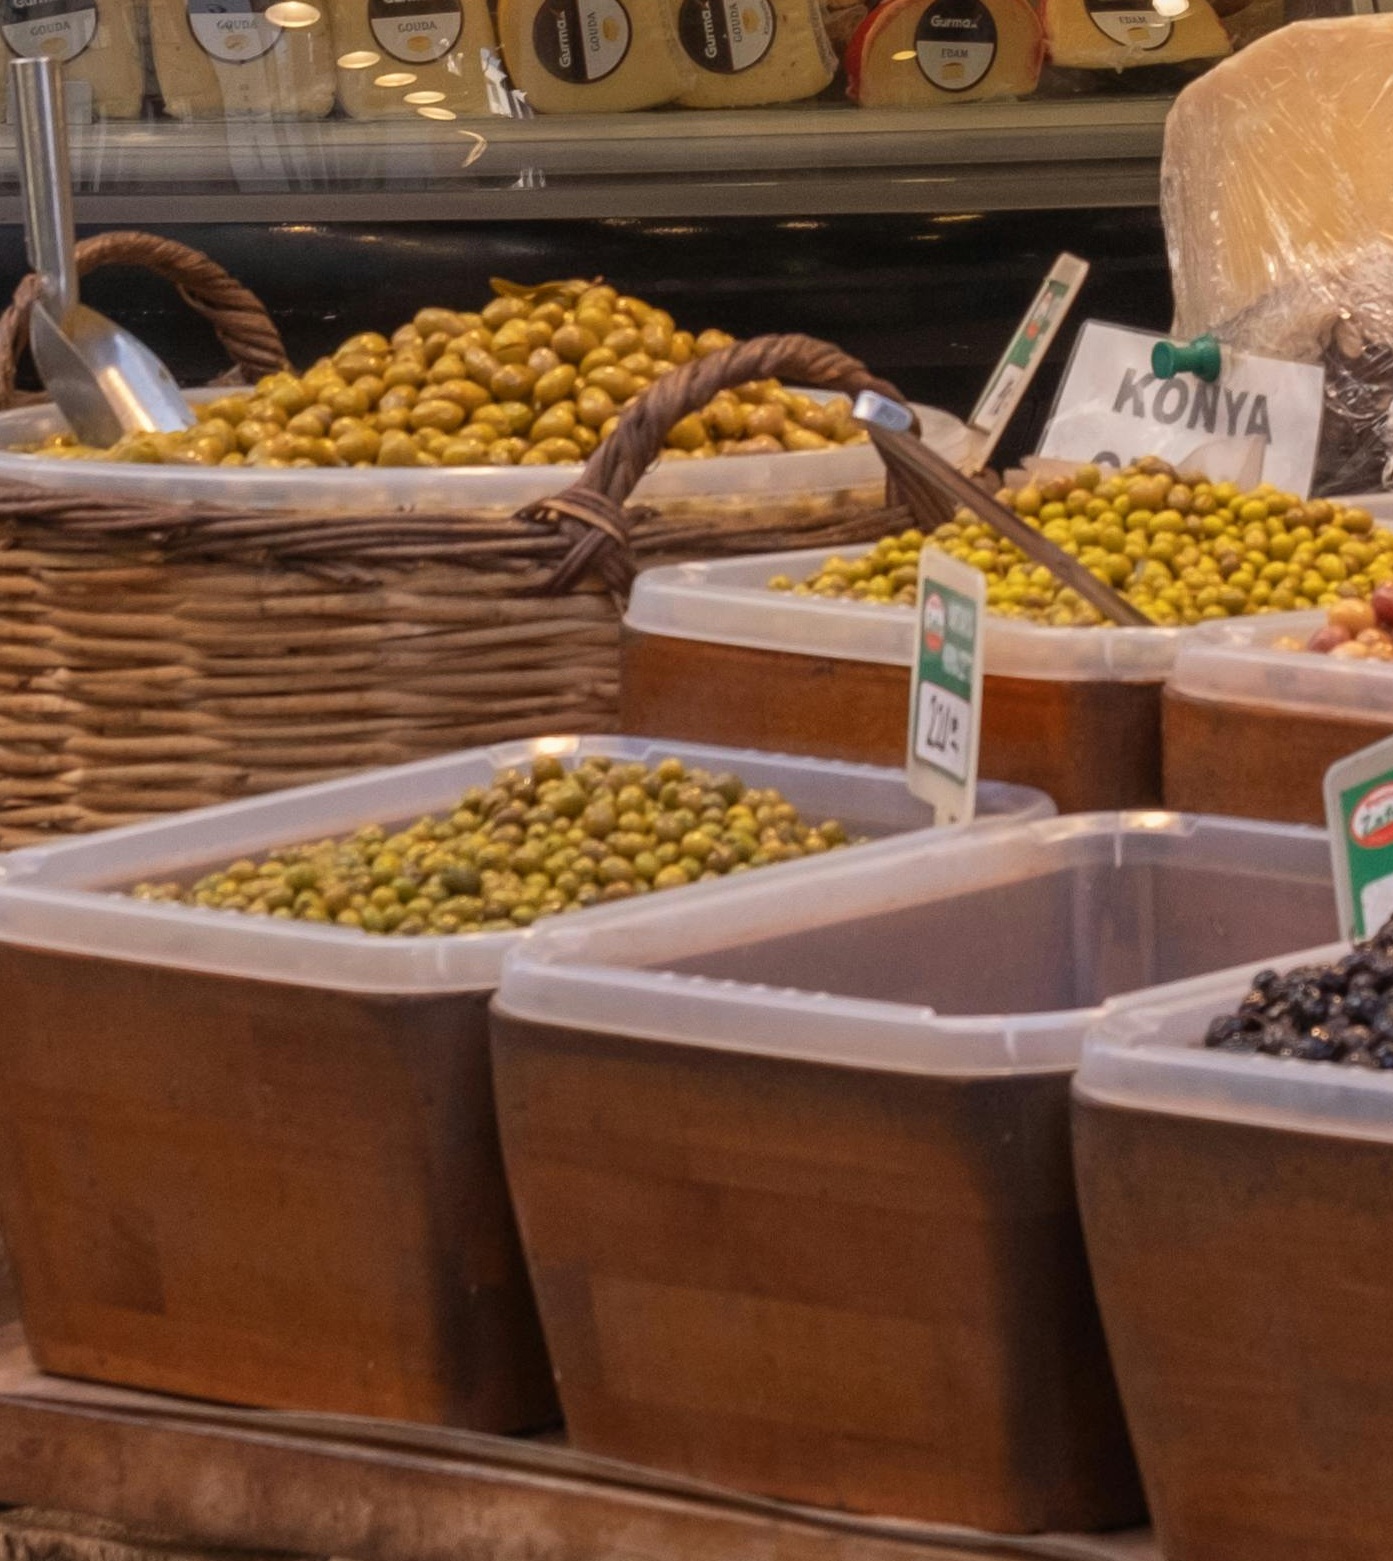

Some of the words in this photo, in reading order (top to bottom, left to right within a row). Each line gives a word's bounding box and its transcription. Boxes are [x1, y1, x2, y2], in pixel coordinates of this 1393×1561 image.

[398, 21, 438, 33] GOUDA
[587, 11, 601, 52] GOUDA
[729, 3, 742, 42] GOUDA
[1112, 367, 1272, 445] KONYA
